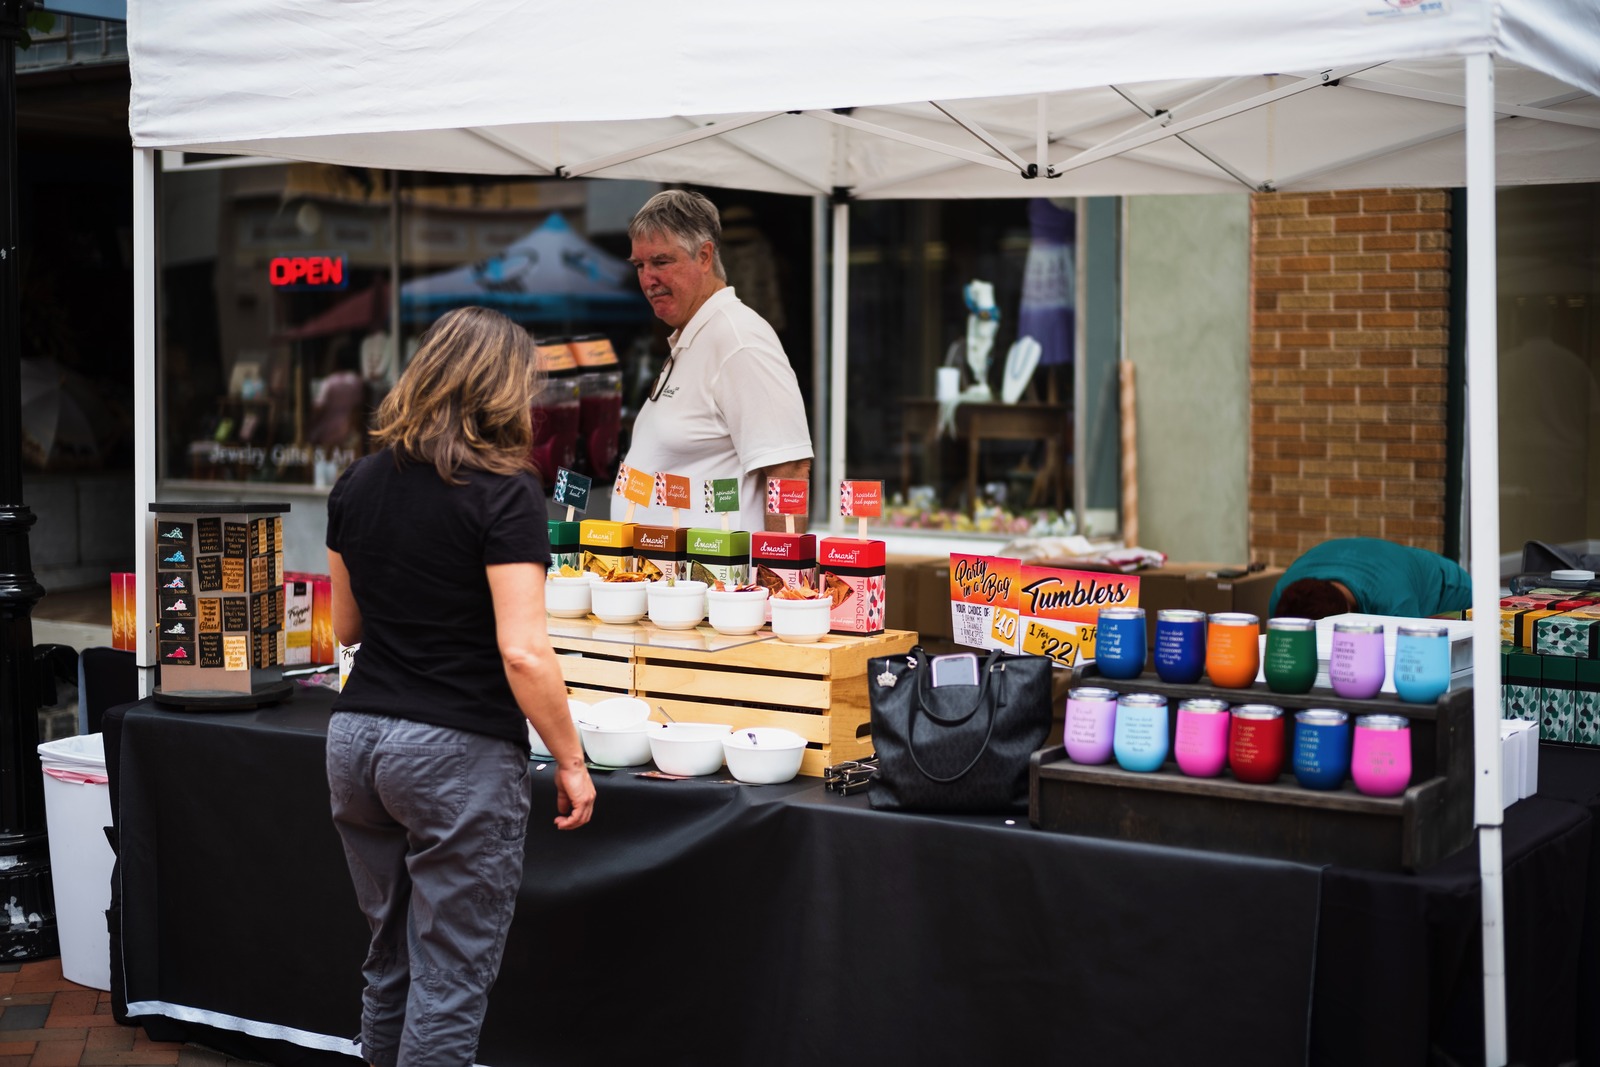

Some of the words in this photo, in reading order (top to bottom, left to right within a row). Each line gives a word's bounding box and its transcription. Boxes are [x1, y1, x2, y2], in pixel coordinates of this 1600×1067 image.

[269, 256, 343, 286] OPEN
[715, 487, 737, 496] spinach
[781, 491, 804, 499] sundried
[854, 490, 878, 498] roasted
[955, 557, 988, 587] Party
[963, 583, 971, 598] in
[974, 582, 979, 592] a
[982, 573, 1012, 603] Bag
[1021, 577, 1131, 615] Tumblers
[855, 580, 865, 630] TRIANGLES
[956, 604, 966, 613] YOUR
[968, 605, 982, 616] CHOICE
[199, 621, 220, 631] Glass!
[995, 607, 1016, 641] $40
[1029, 624, 1036, 636] 1
[1036, 627, 1050, 640] for
[1081, 628, 1088, 641] 2
[1041, 637, 1073, 665] $22
[201, 656, 221, 666] Glass!
